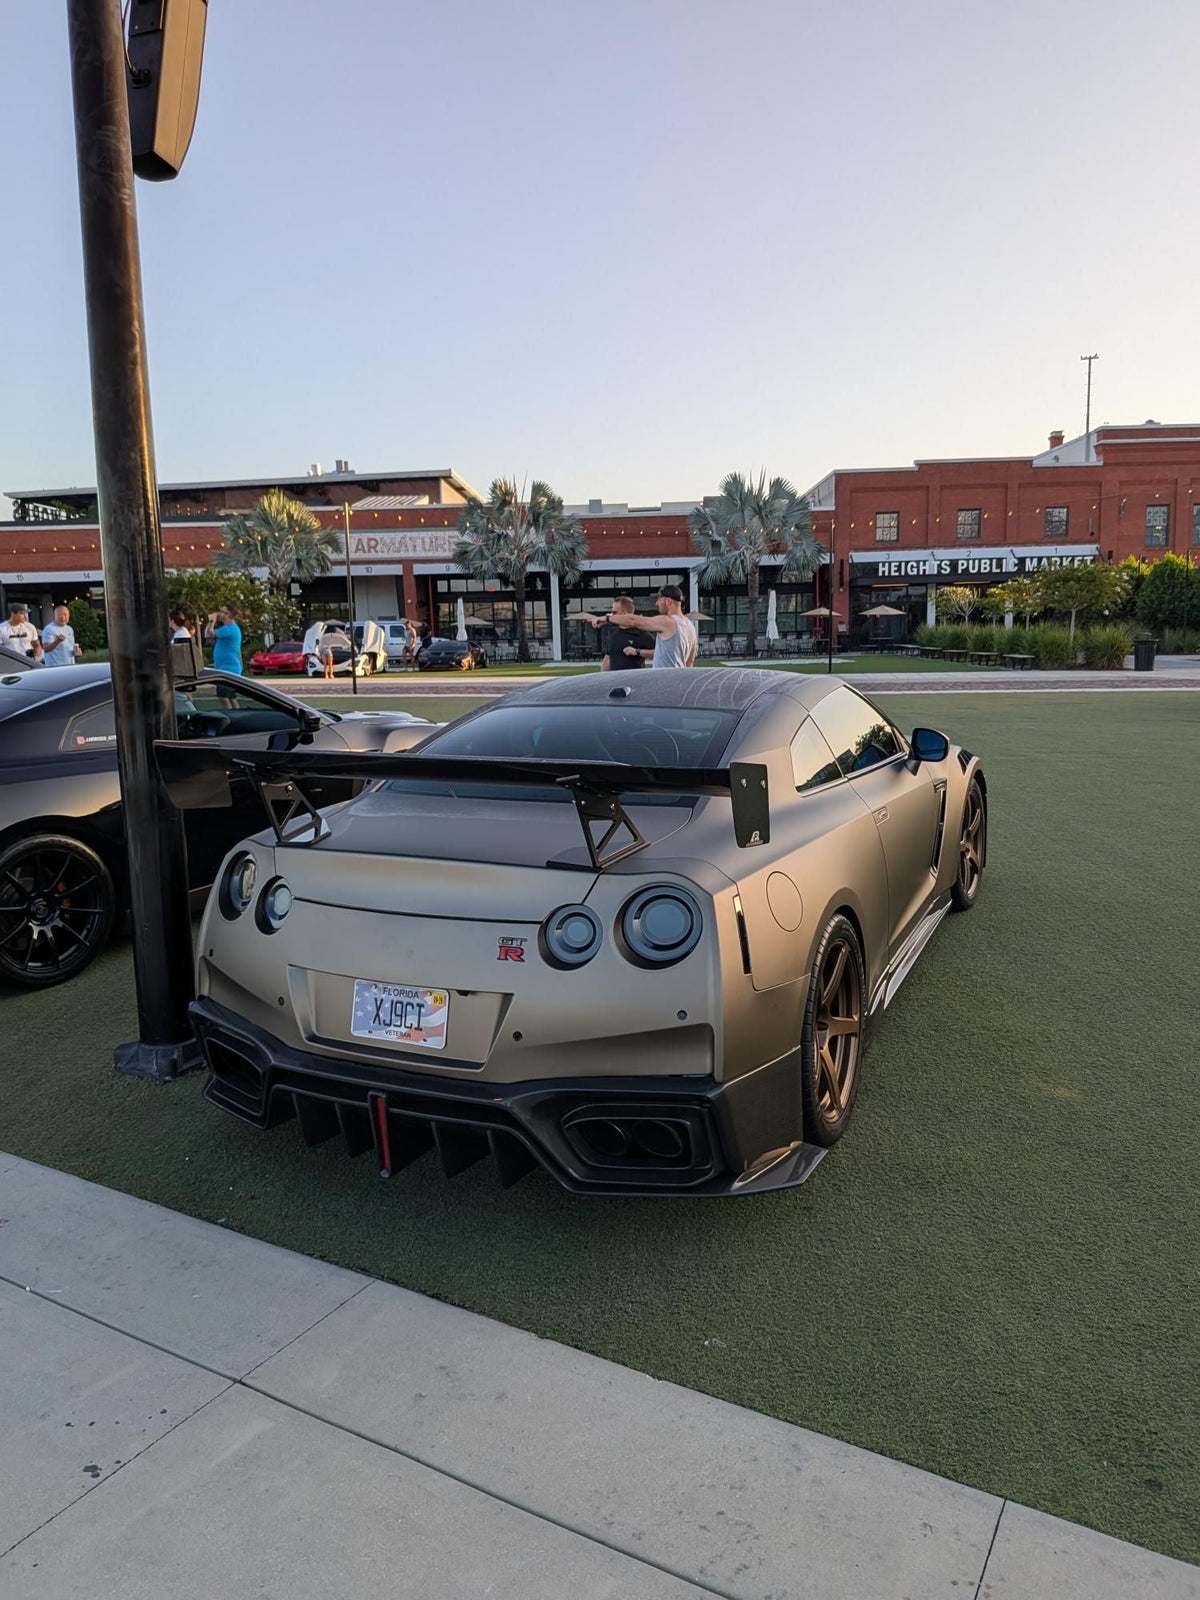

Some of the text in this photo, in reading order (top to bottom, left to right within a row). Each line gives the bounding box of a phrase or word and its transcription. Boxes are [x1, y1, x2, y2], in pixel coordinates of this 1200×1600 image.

[878, 560, 950, 576] HEIGHTS
[958, 559, 1018, 574] PUBLIC
[382, 987, 419, 999] FLORIDA
[372, 997, 425, 1032] XJ9CI
[385, 1030, 411, 1038] VETERAN
